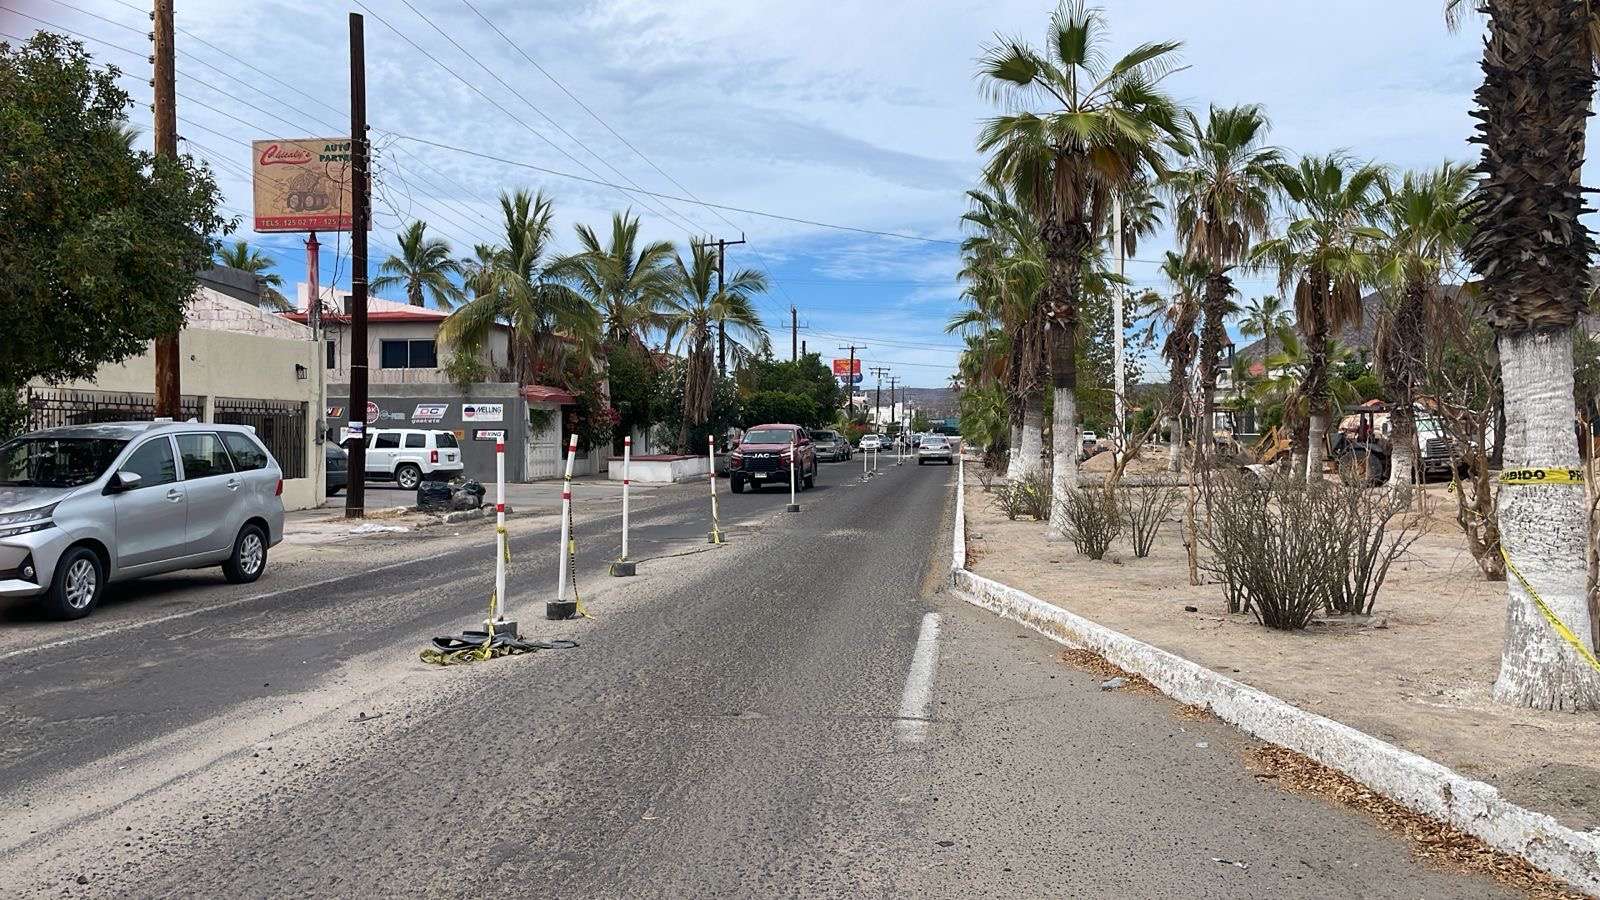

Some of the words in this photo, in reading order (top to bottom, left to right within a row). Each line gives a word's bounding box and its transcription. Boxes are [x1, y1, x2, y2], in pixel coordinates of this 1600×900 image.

[324, 142, 350, 152] AUTO
[319, 154, 353, 162] PARTE
[475, 406, 502, 414] MELLING
